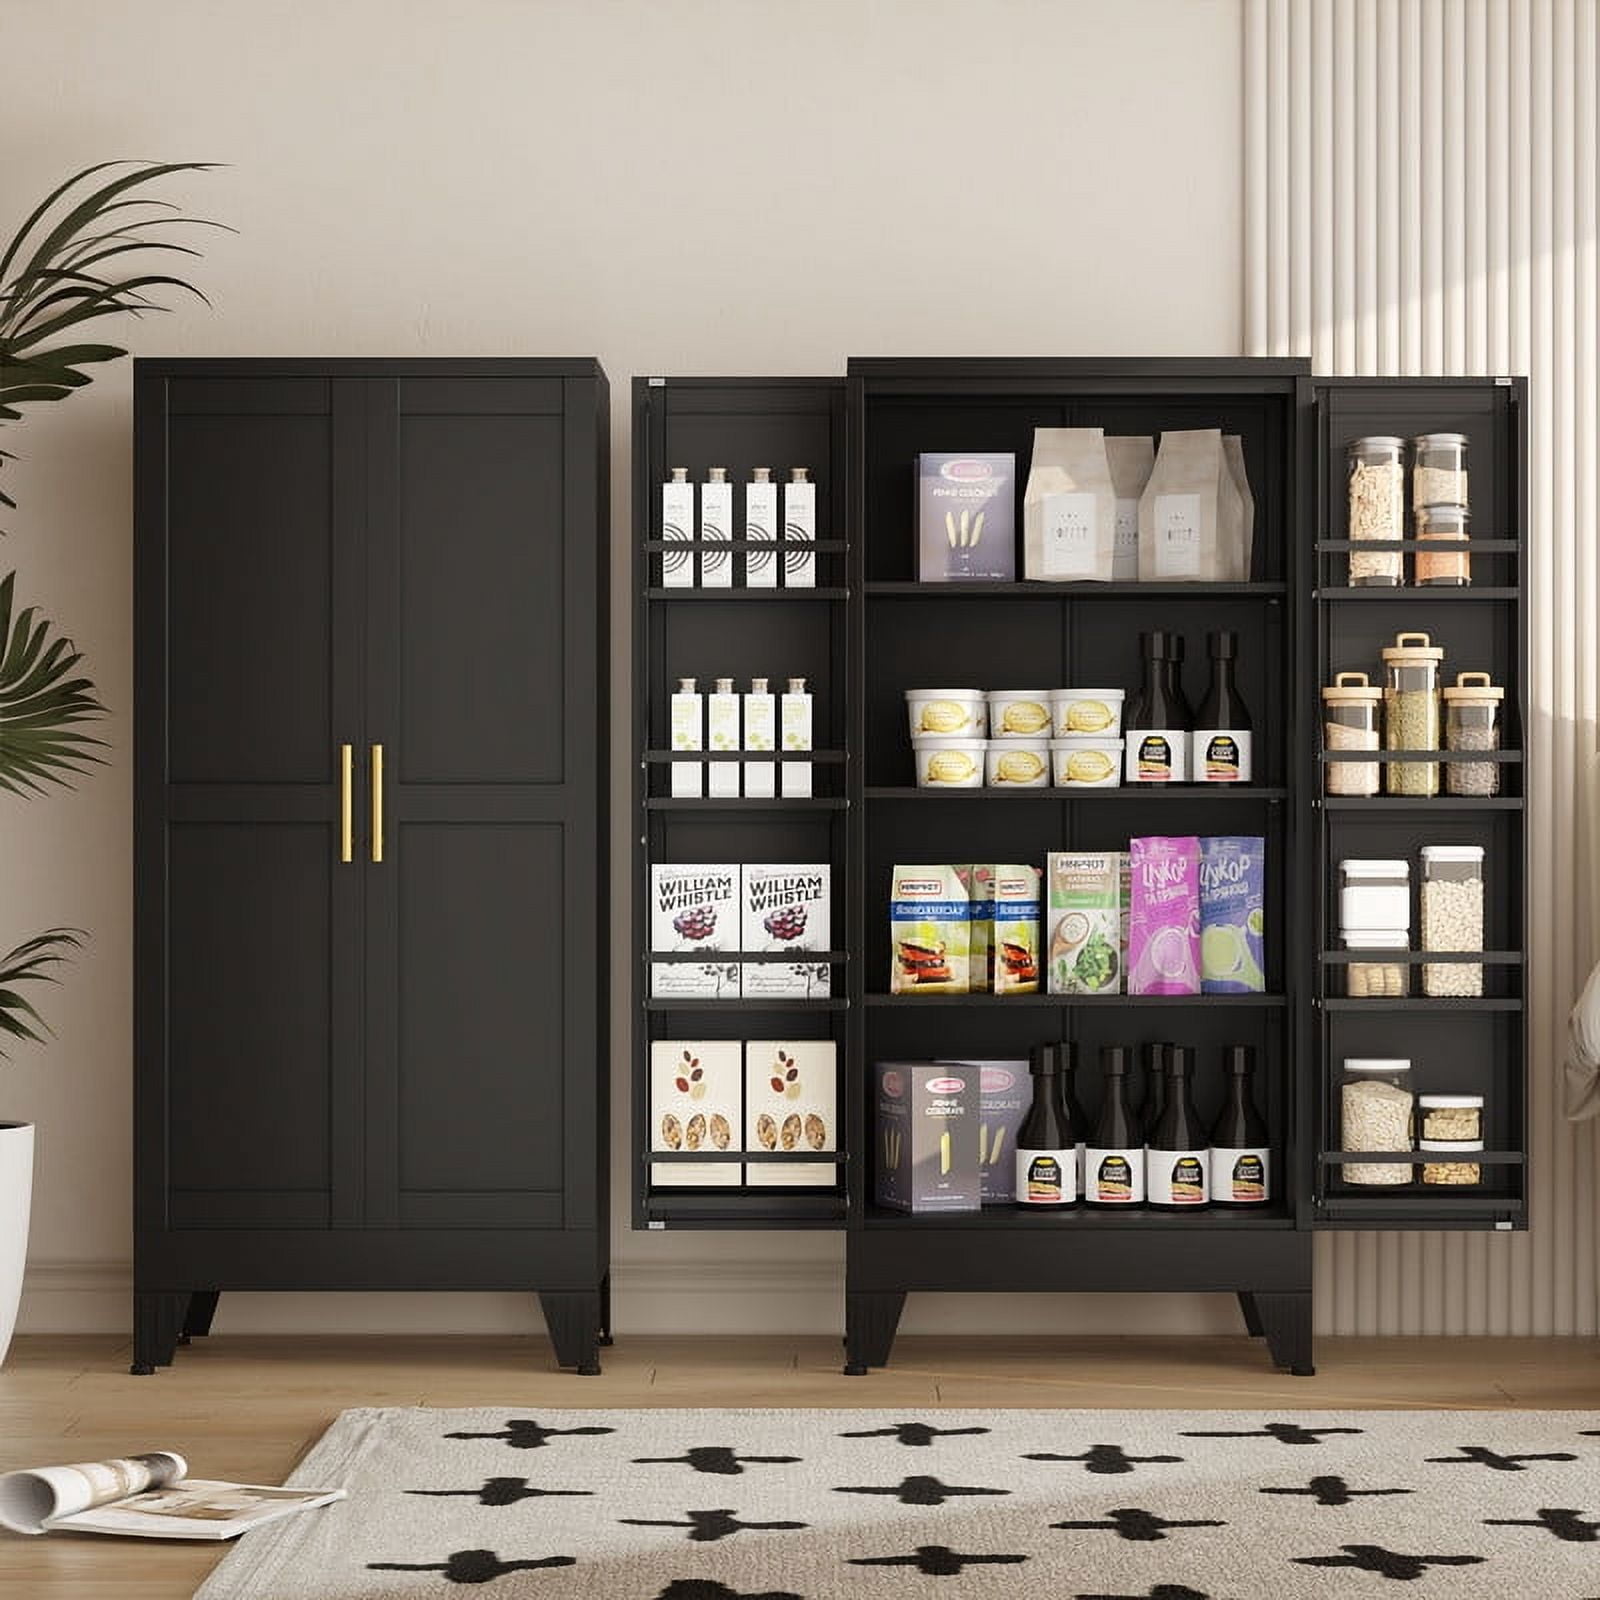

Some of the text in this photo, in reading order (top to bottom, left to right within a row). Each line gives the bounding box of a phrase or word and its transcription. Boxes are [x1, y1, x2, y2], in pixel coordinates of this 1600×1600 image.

[659, 877, 732, 897] WILLIAM
[750, 877, 823, 897] WILLIAM
[659, 889, 732, 912] WHISTLE
[750, 889, 823, 912] WHISTLE
